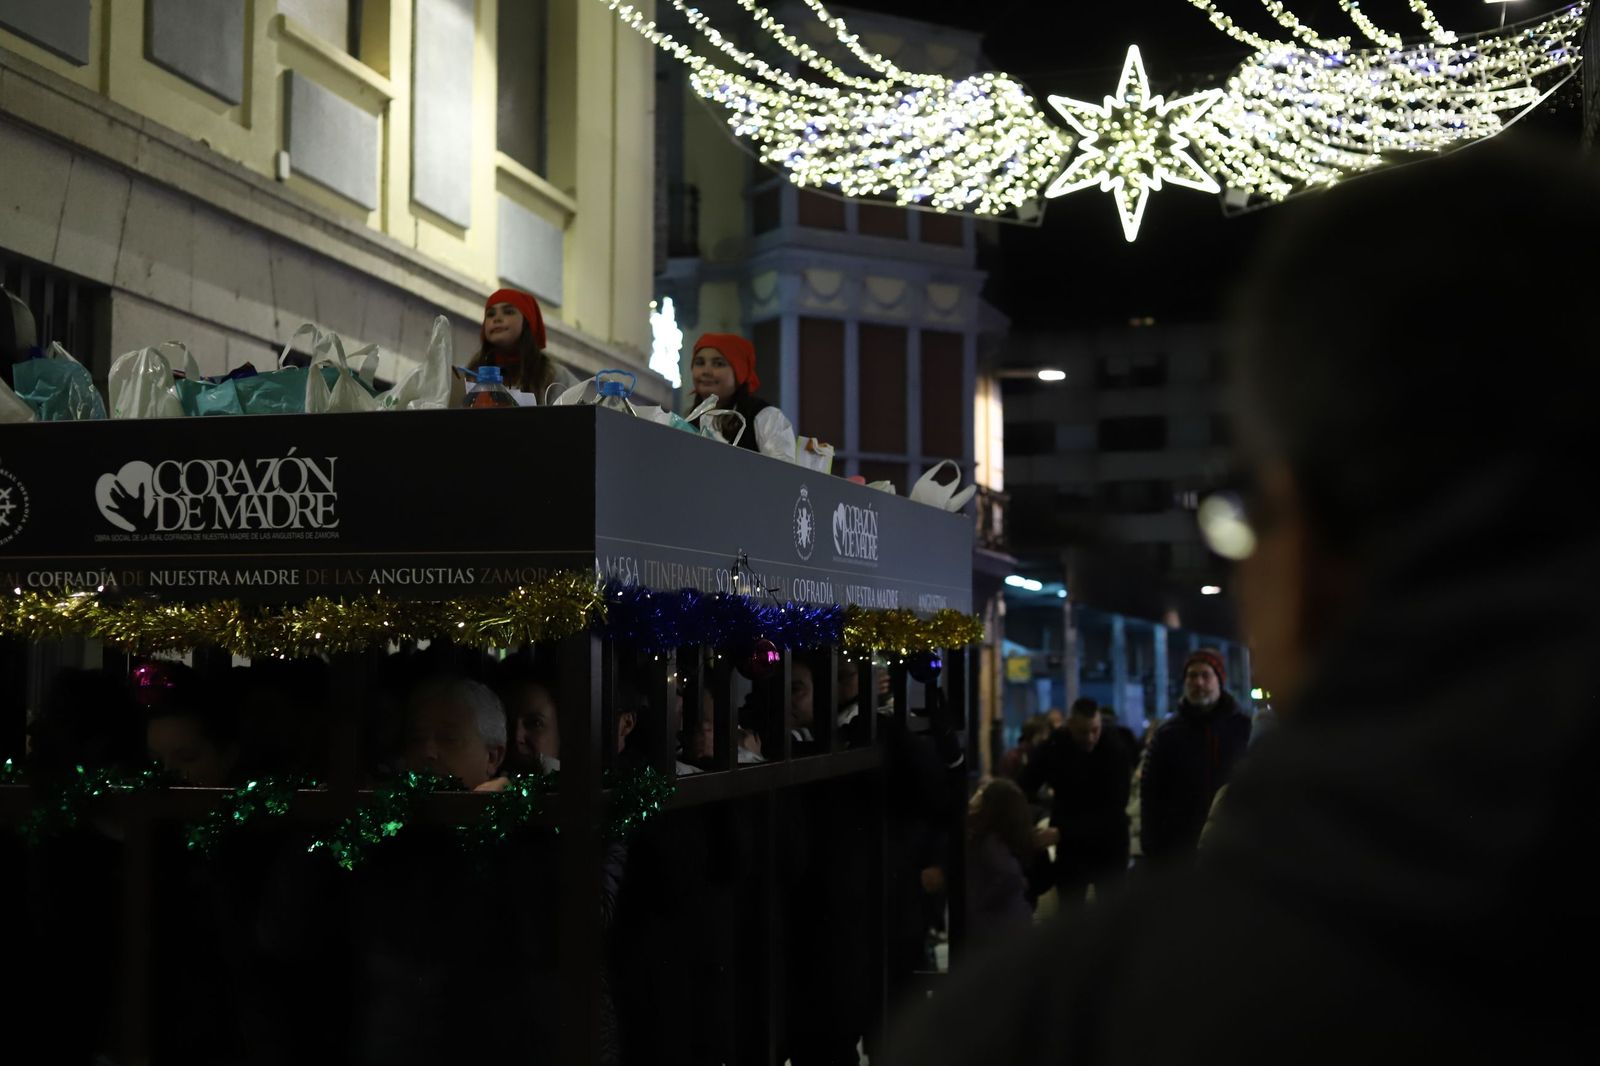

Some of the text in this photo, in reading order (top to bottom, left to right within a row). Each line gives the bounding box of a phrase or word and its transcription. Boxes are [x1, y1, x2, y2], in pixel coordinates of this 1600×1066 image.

[151, 446, 338, 497] CORAZÓN
[153, 492, 340, 532] DE MADRE
[27, 567, 117, 587] COFRADÍA
[122, 571, 143, 586] DE
[149, 570, 231, 586] NUESTRA
[234, 569, 300, 585] MADRE
[305, 569, 329, 585] DE
[335, 569, 364, 584] LAS
[368, 567, 475, 584] ANGUSTIAS
[480, 567, 548, 584] ZAMOR
[644, 560, 713, 594] ITINERANTE
[793, 577, 834, 604] COFRADÍA
